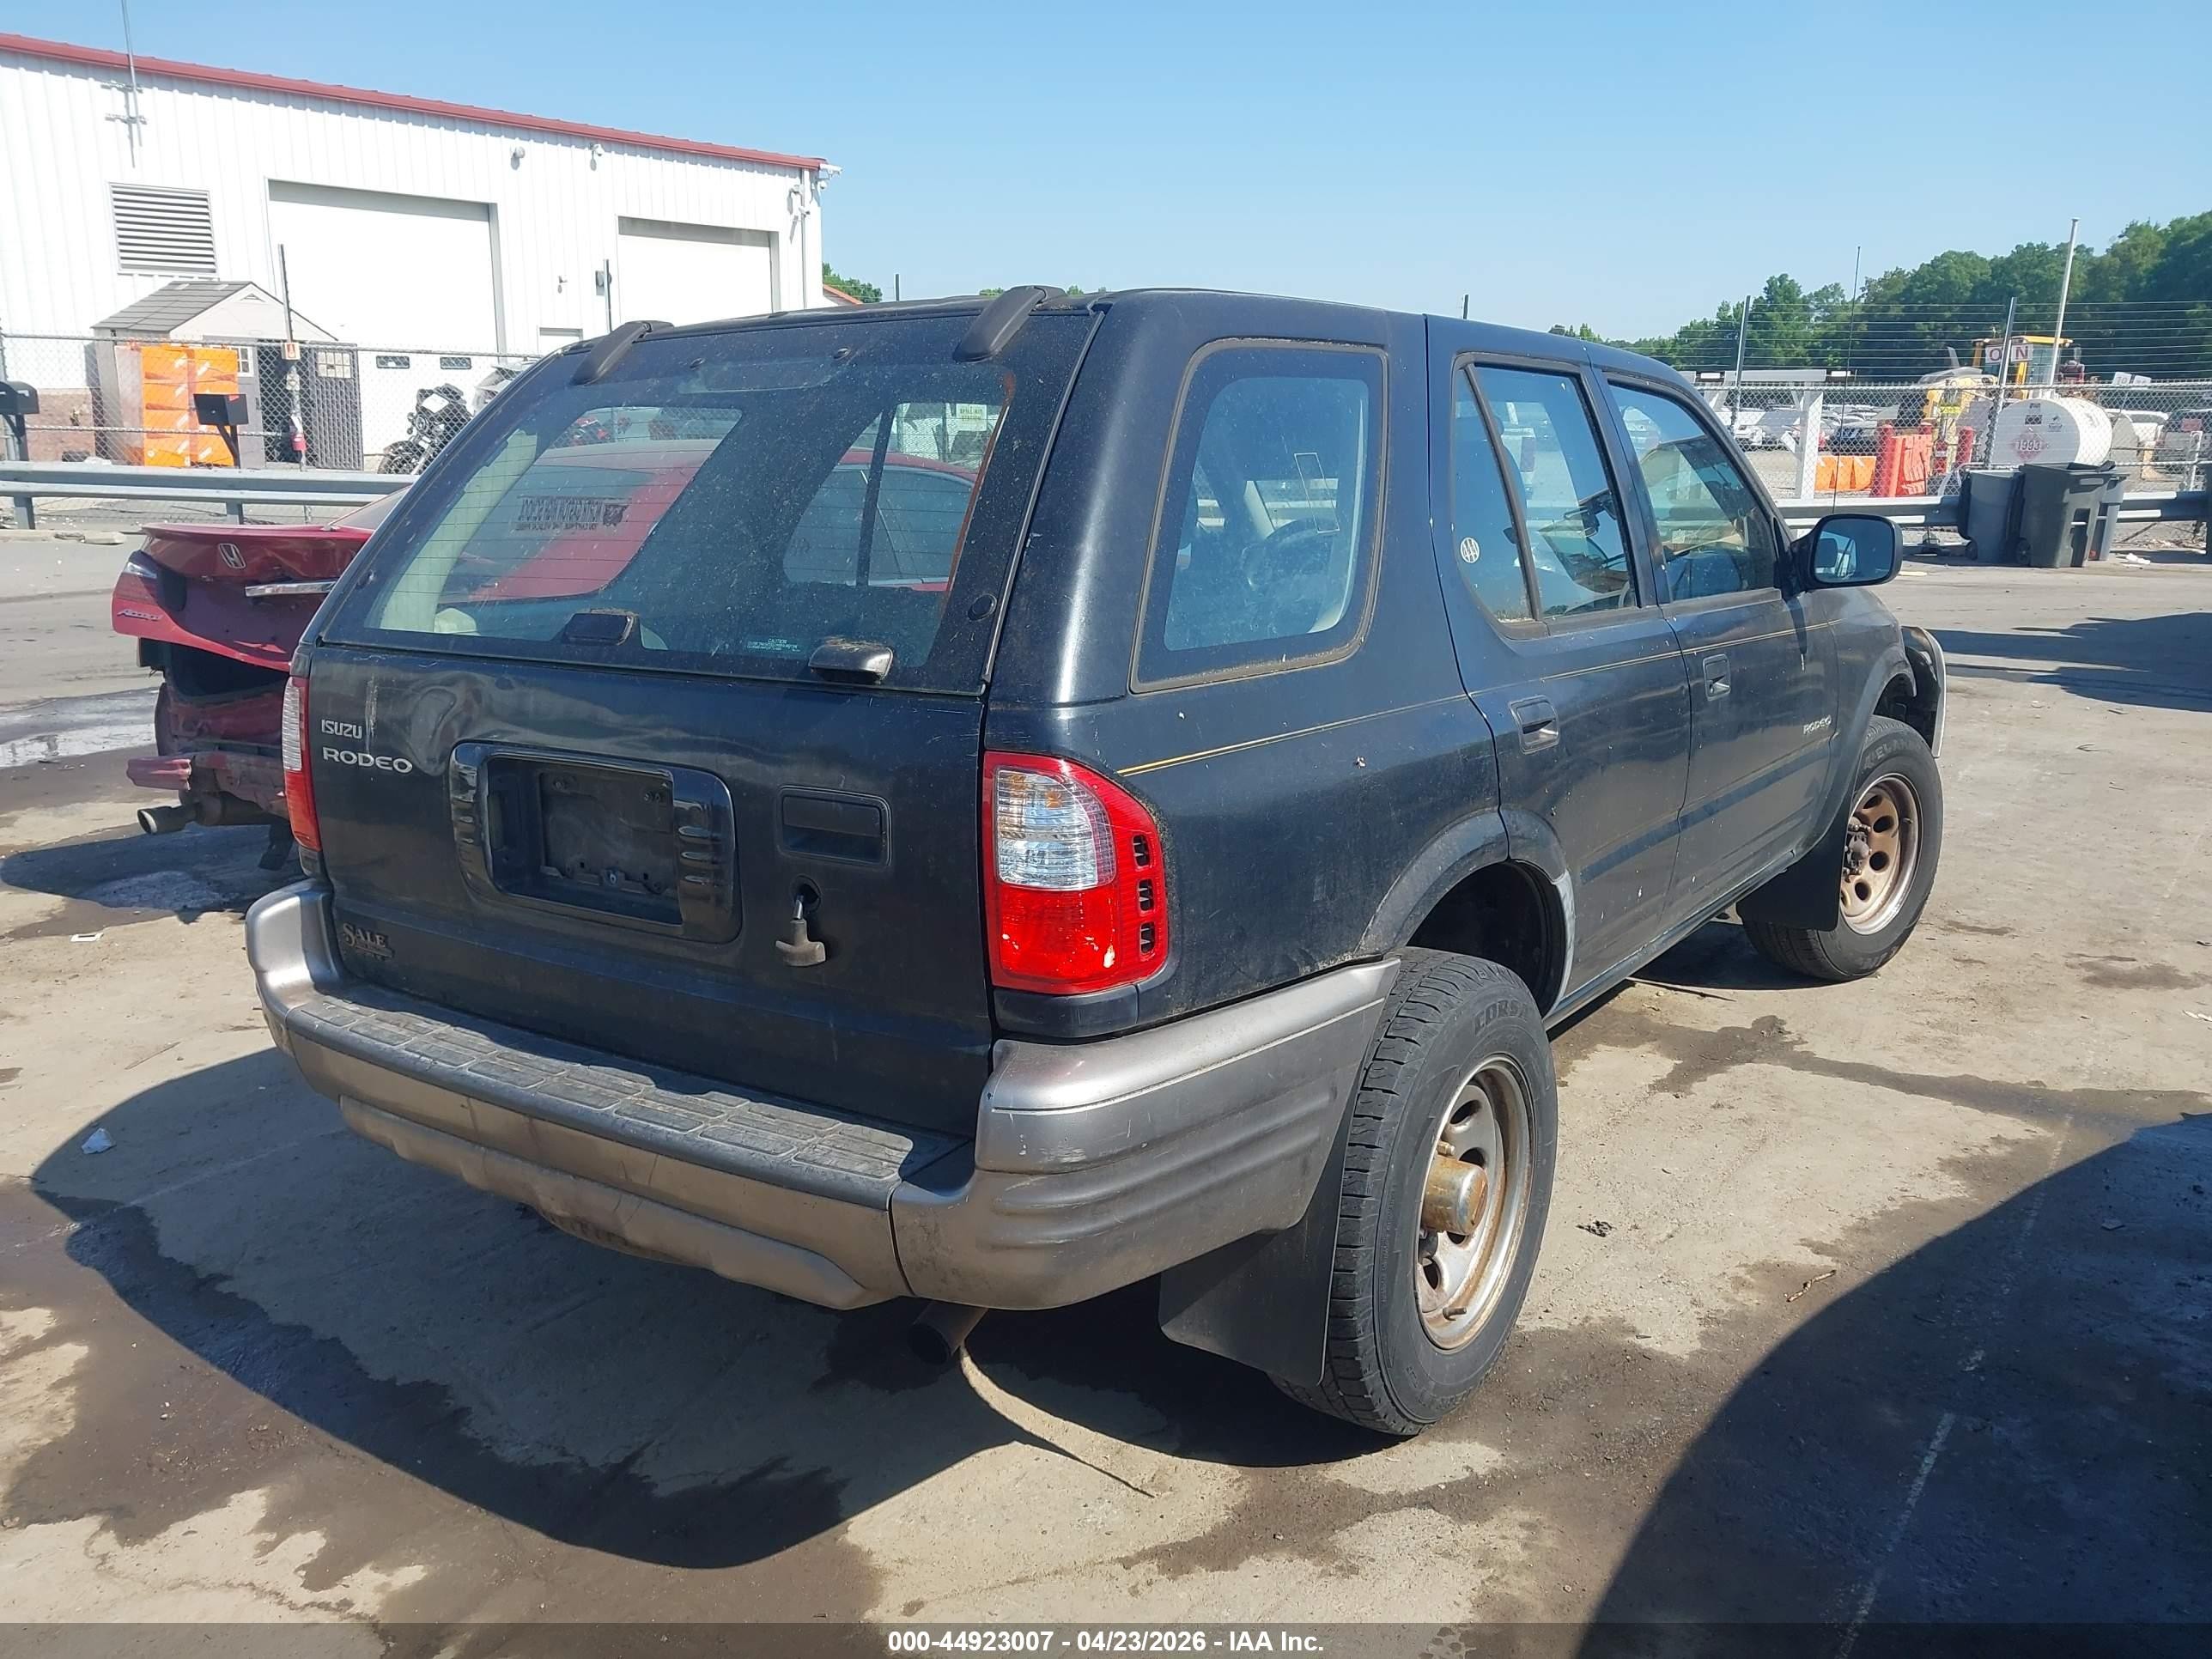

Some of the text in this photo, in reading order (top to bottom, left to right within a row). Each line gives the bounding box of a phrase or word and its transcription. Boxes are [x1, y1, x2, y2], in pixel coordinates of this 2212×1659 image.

[2016, 439, 2041, 451] 1993
[321, 719, 362, 739] ISUZU
[1802, 714, 1832, 735] RODEO
[322, 746, 413, 774] RODEO
[343, 922, 386, 949] SALE
